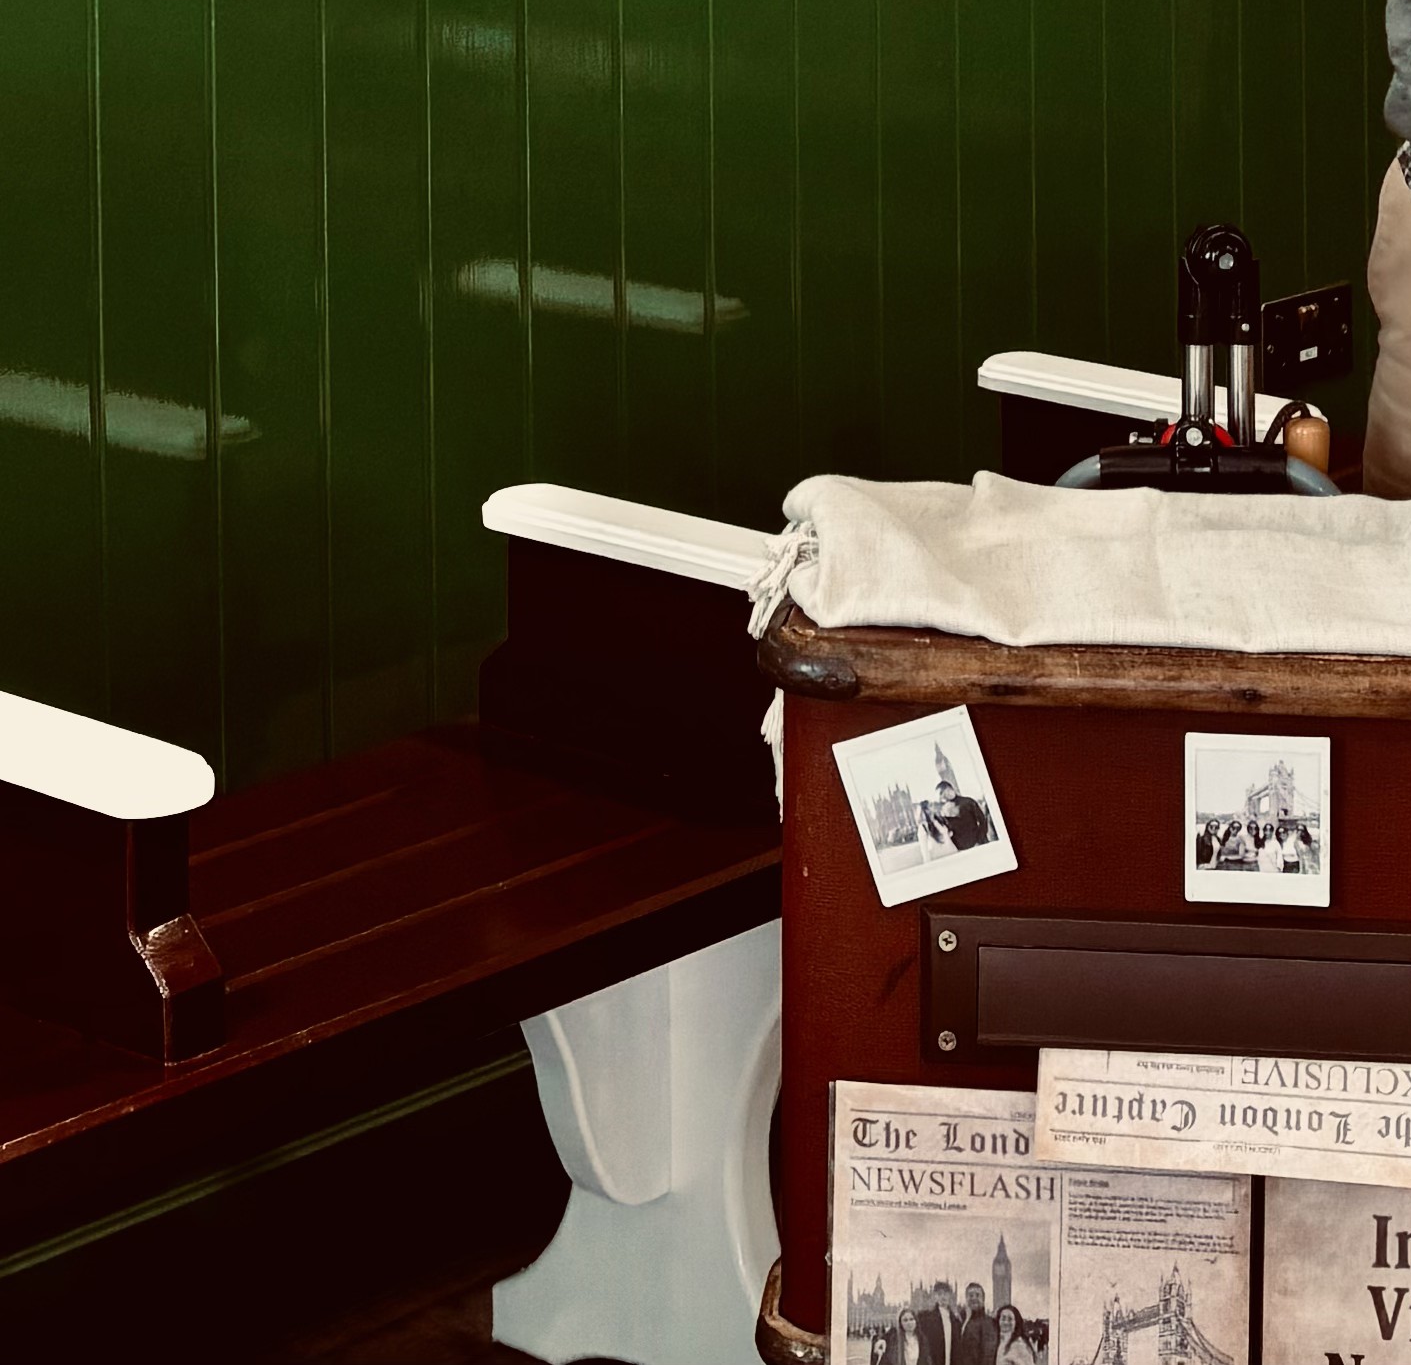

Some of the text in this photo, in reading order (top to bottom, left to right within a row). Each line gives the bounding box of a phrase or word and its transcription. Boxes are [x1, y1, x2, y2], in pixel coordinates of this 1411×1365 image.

[1053, 1091, 1197, 1133] Capture
[1219, 1104, 1355, 1145] London
[851, 1117, 1030, 1157] The Lond
[851, 1166, 1056, 1201] NEWSFLASH
